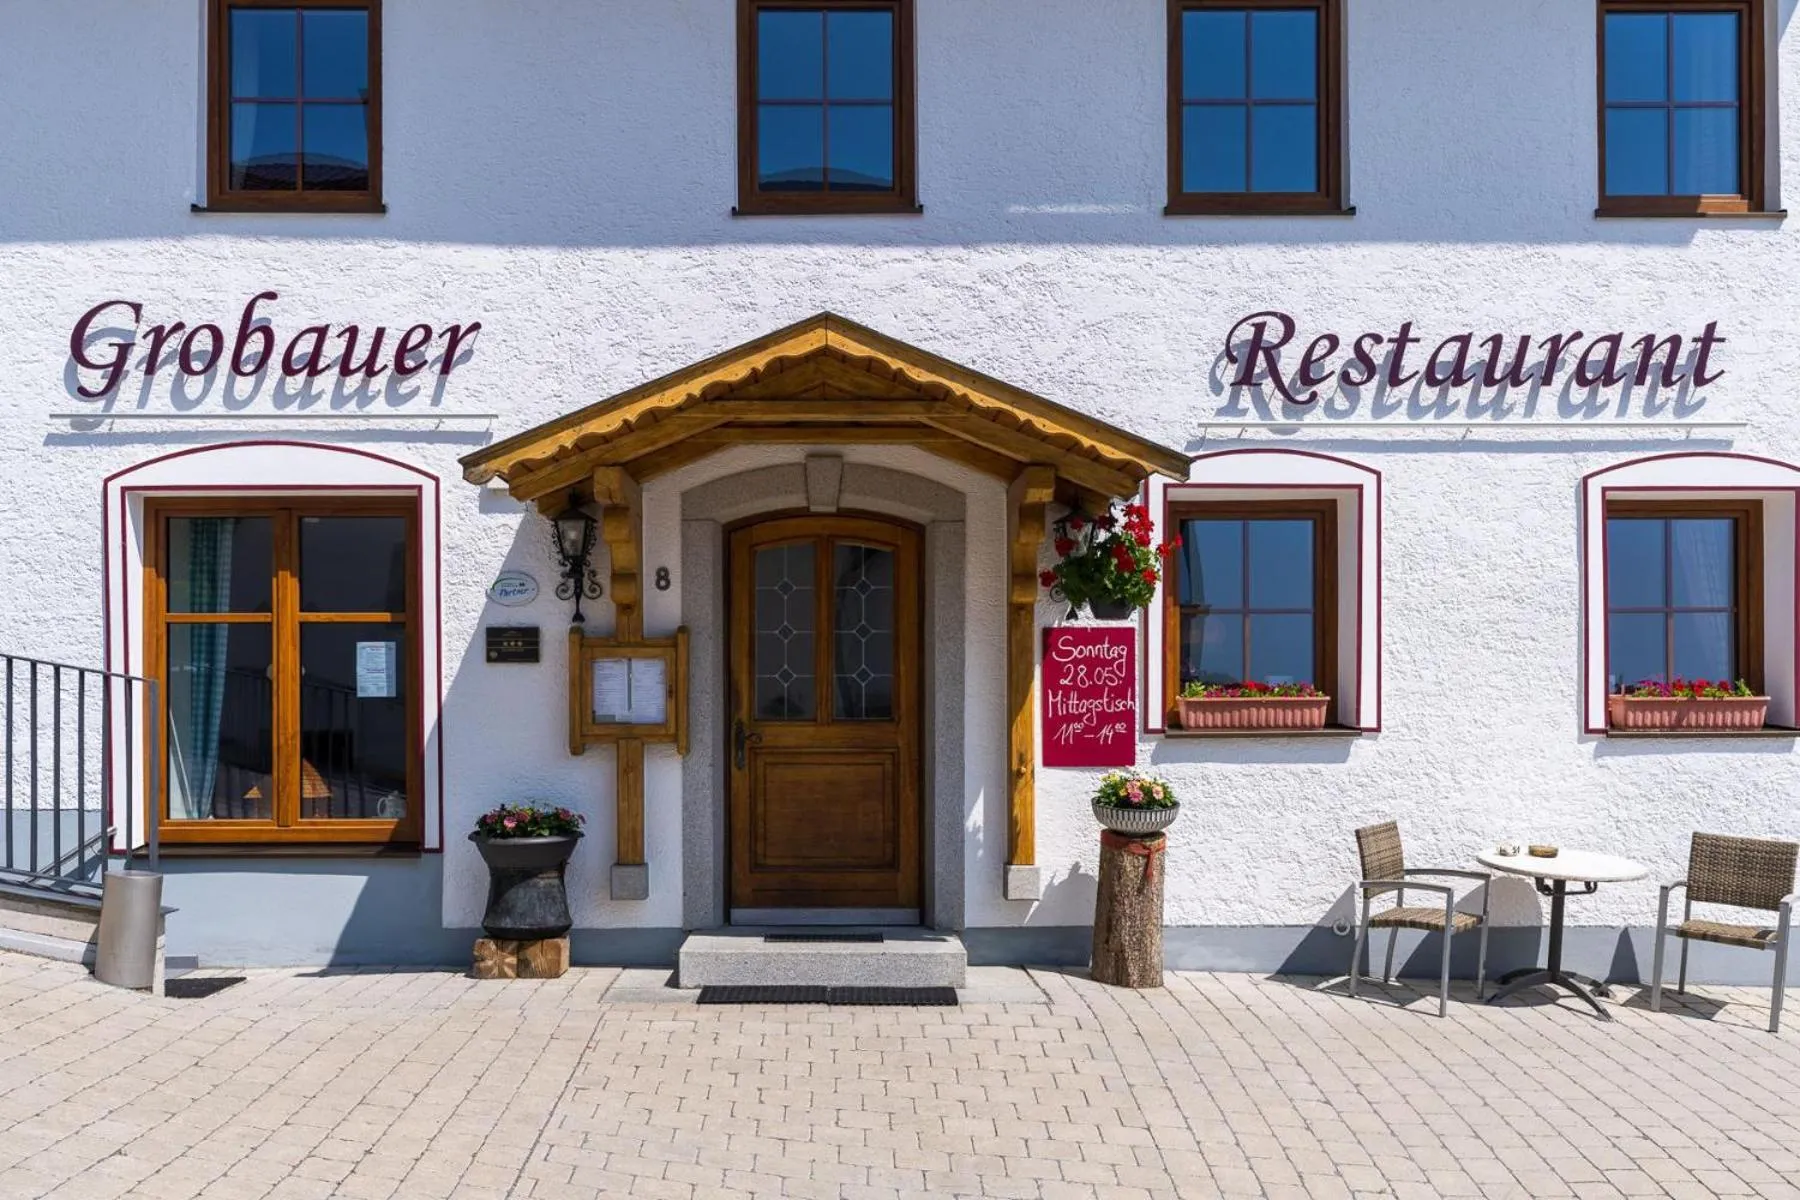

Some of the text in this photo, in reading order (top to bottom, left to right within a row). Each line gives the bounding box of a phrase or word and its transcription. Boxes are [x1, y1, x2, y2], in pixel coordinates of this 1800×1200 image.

[70, 291, 481, 398] Grobauer
[1224, 311, 1727, 405] Restaurant
[655, 566, 671, 590] 8
[1052, 635, 1128, 677] Sonntag
[1048, 686, 1136, 726] Mittagstisch
